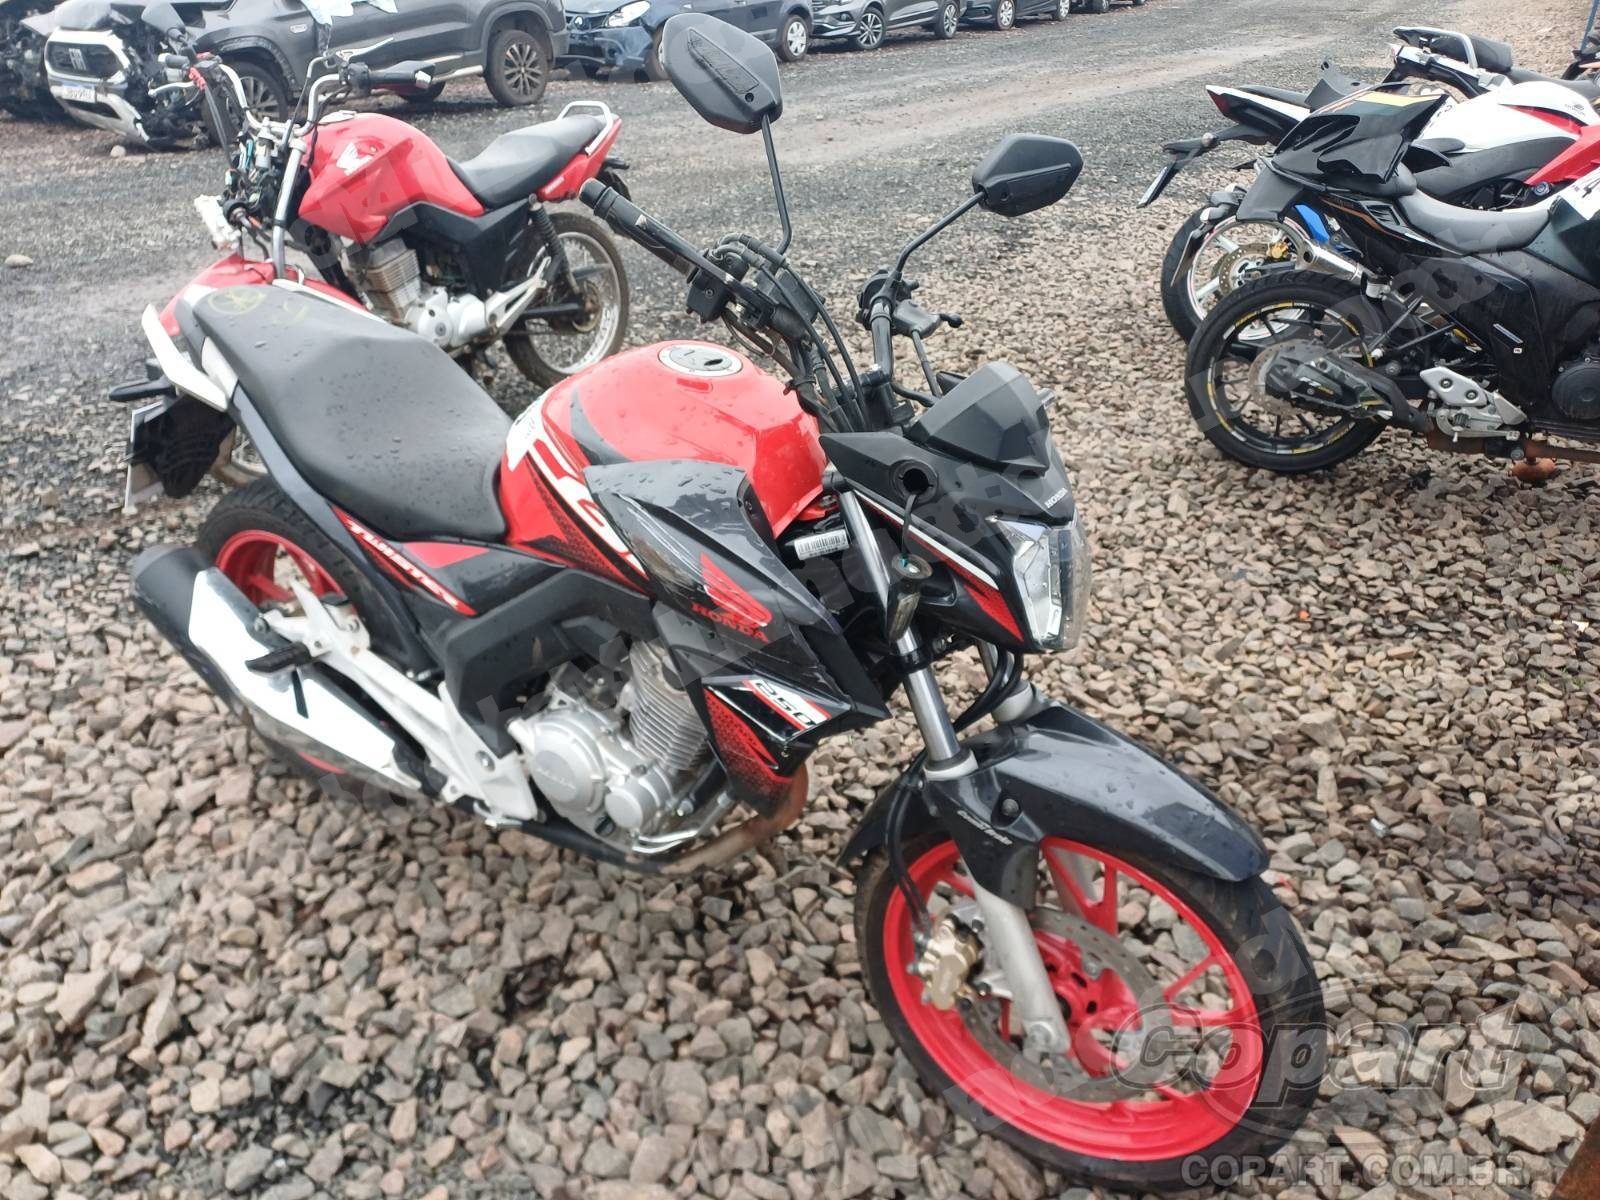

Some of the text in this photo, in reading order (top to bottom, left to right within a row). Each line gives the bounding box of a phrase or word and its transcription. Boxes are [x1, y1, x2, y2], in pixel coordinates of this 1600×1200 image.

[1044, 487, 1068, 509] HONDA
[690, 602, 770, 645] HONDA
[754, 681, 818, 727] 250
